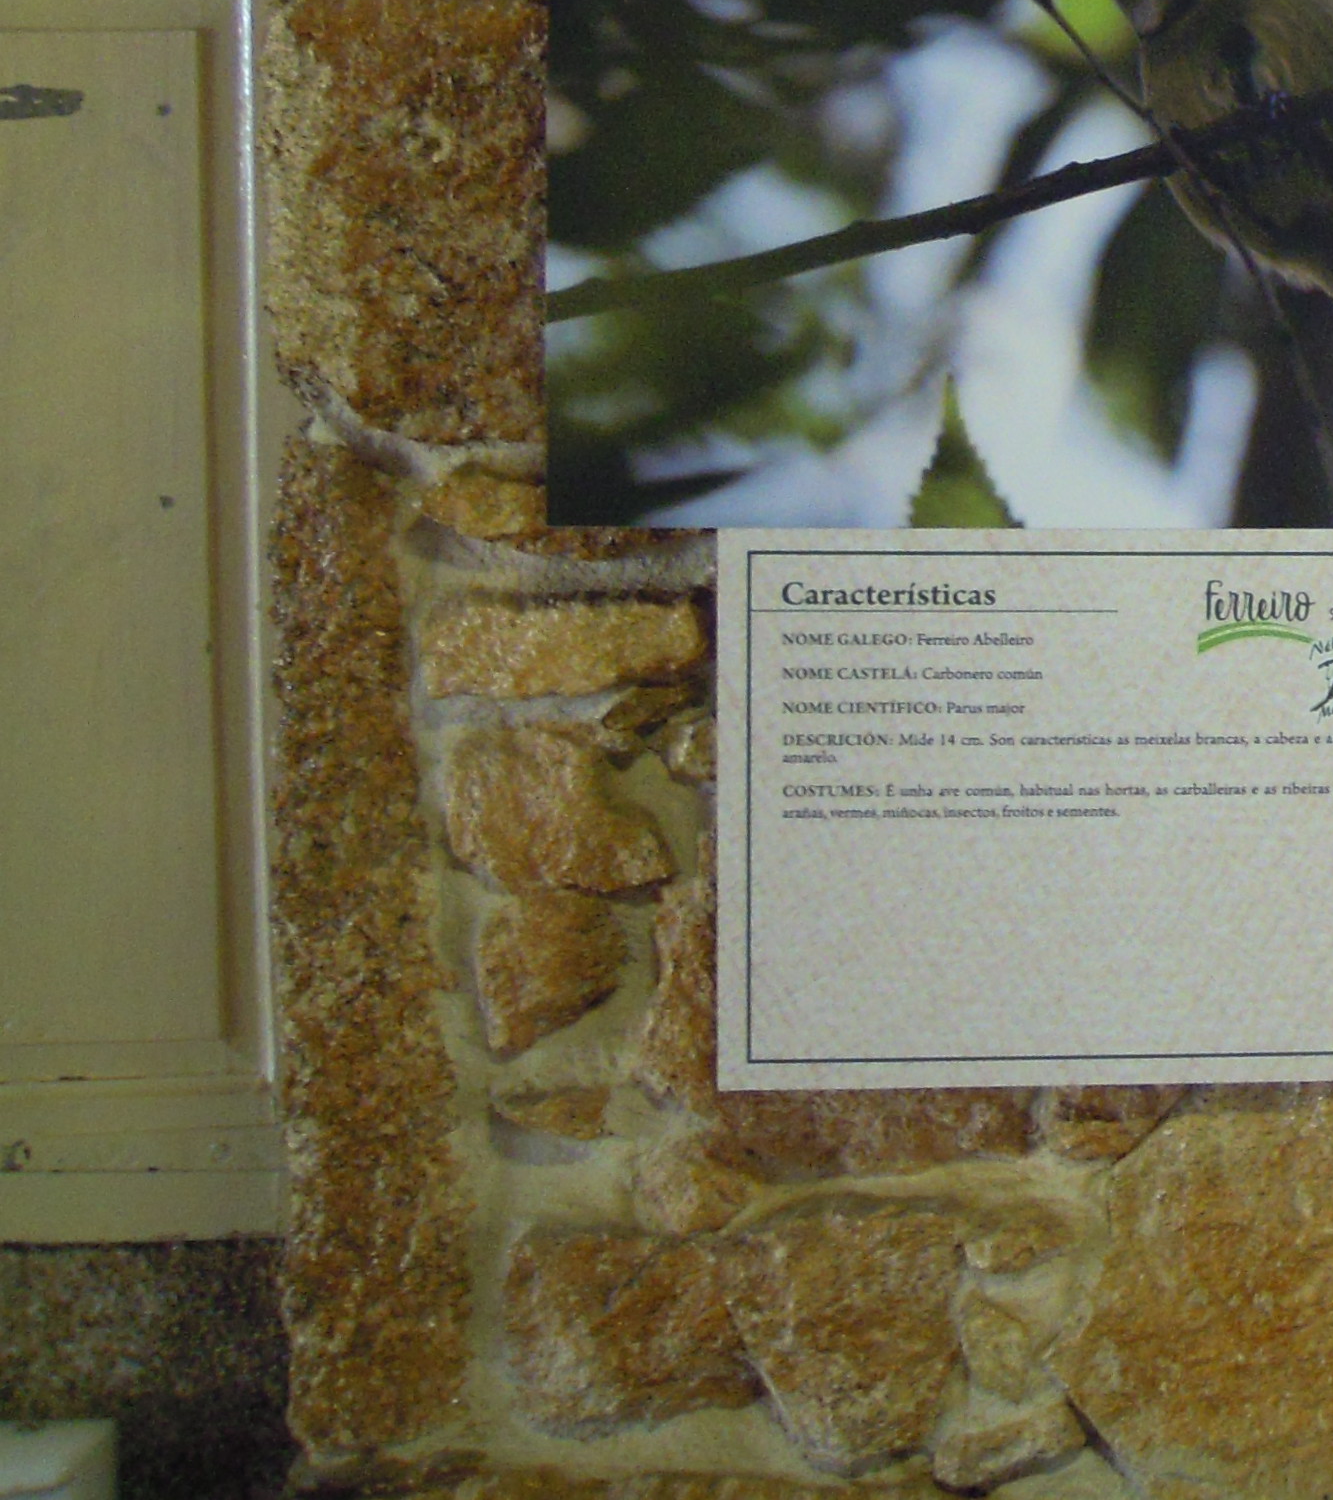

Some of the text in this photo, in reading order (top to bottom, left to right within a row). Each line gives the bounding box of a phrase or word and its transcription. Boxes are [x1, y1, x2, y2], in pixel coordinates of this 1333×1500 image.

[781, 582, 996, 606] Características
[1205, 580, 1316, 621] Ferreiro
[782, 632, 1034, 647] NOME GALEGO: Ferreiro Abelleiro
[782, 667, 832, 681] NOME
[837, 666, 917, 680] CASTELÁ:
[921, 666, 993, 681] Carbonero
[782, 701, 833, 715] NOME
[946, 701, 982, 715] Parus
[985, 704, 1025, 716] major
[898, 732, 934, 747] Mide
[940, 733, 955, 747] 14
[989, 733, 1015, 747] Son
[1117, 736, 1129, 746] as
[1265, 731, 1309, 745] cabeza
[782, 784, 880, 798] COSTUMES:
[900, 783, 933, 798] unha
[938, 787, 959, 798] ave
[1019, 783, 1073, 797] habitual
[1078, 787, 1100, 797] nas
[1155, 786, 1168, 796] as
[1173, 782, 1246, 796] carballeiras
[1263, 785, 1277, 796] as
[1282, 781, 1329, 795] ribeiras
[1002, 804, 1044, 818] froitos
